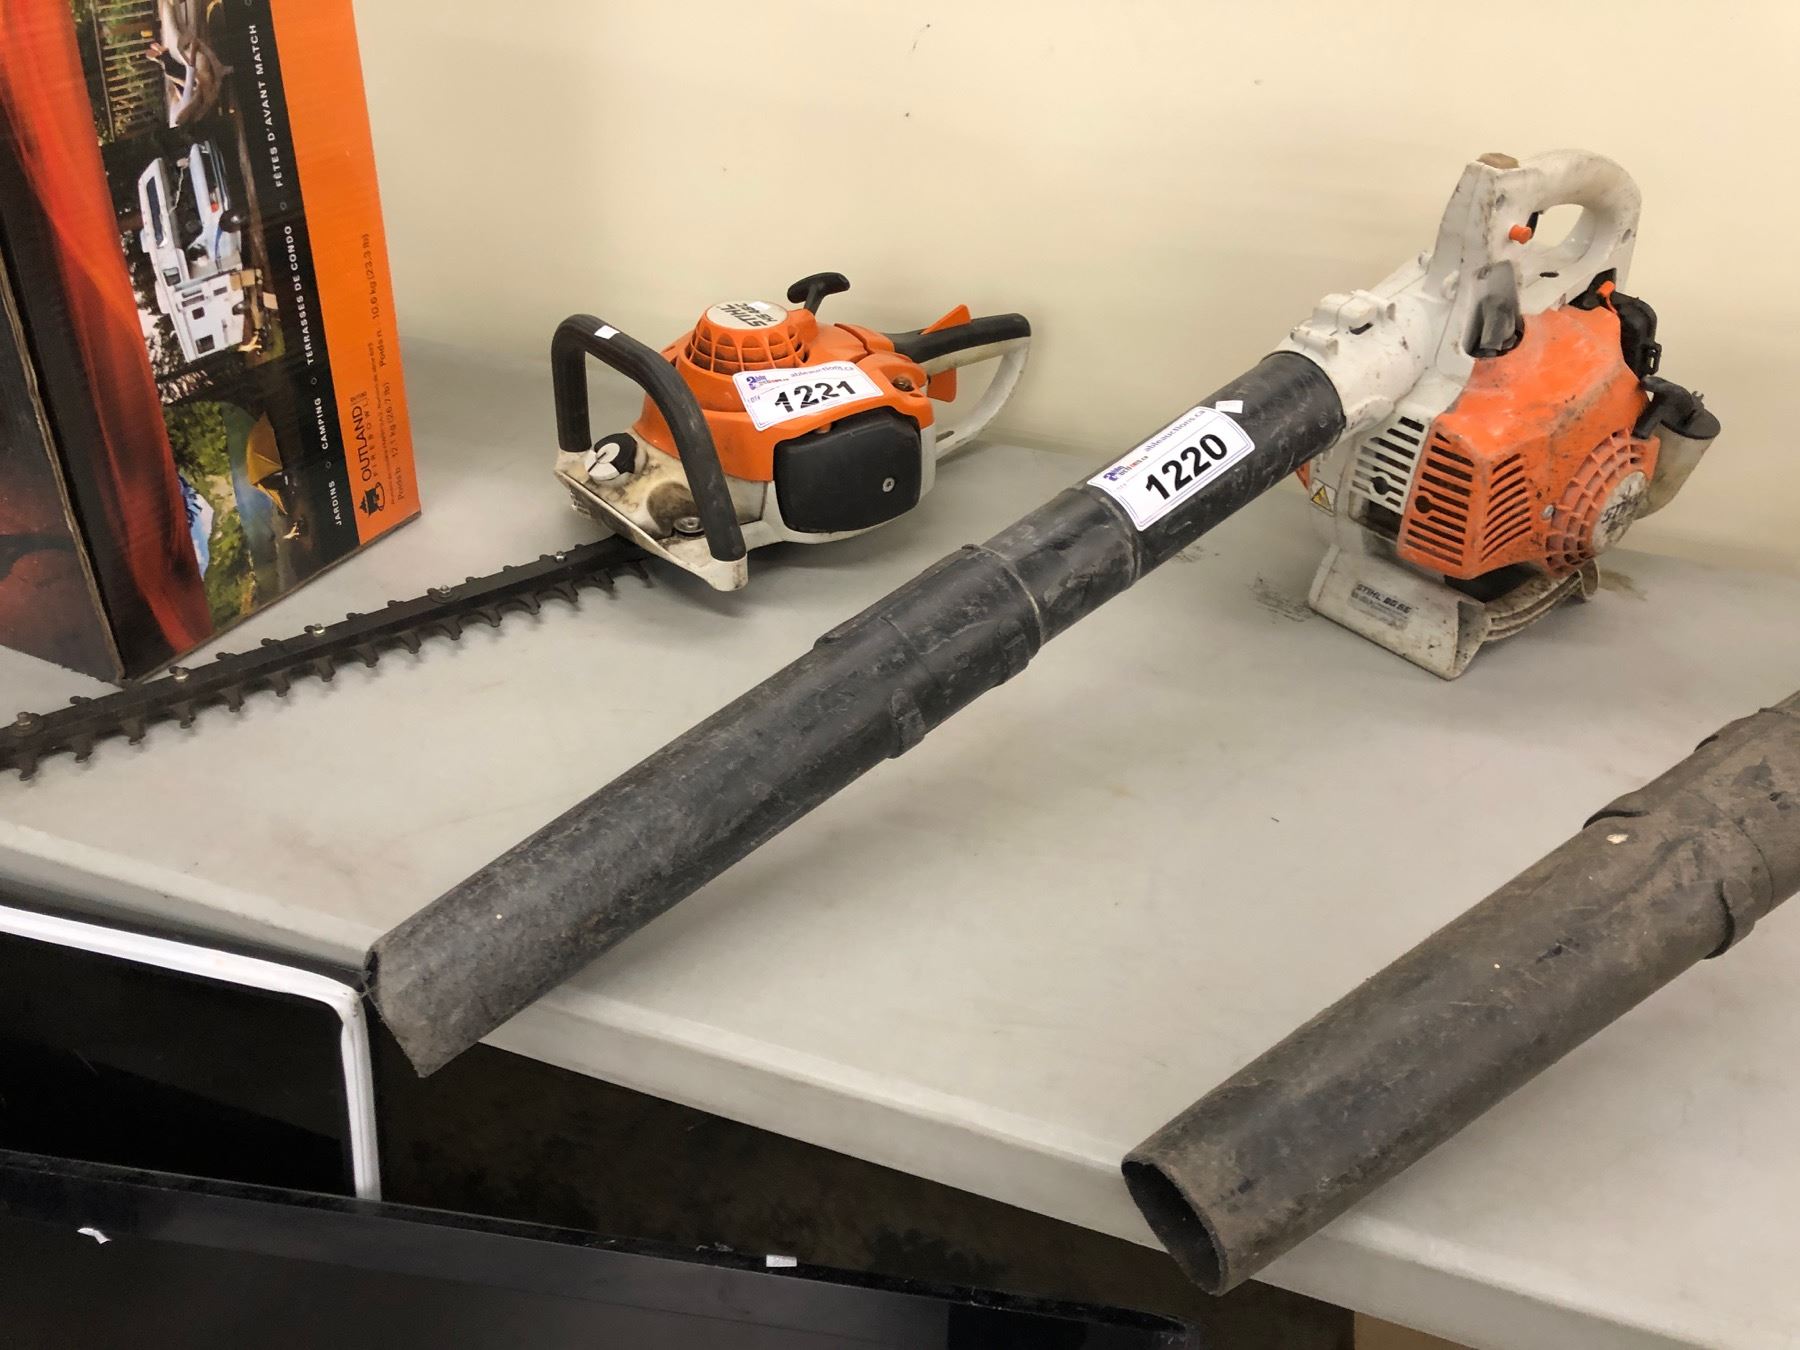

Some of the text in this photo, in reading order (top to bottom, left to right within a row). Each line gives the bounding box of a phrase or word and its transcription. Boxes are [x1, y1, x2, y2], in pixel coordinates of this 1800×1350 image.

[249, 24, 264, 75] MATCH
[258, 81, 276, 141] D'AVANT
[284, 225, 299, 271] CONDO
[292, 274, 302, 292] DE
[369, 280, 377, 295] kg
[296, 294, 314, 366] TERRASSES
[720, 304, 768, 327] STIHL
[377, 338, 386, 368] Poids
[774, 380, 856, 413] 1221
[314, 397, 329, 450] CAMPING
[352, 405, 372, 482] OUTLAND
[364, 401, 377, 477] FIREBOWL
[1144, 410, 1206, 452] ableauctions.ca
[1145, 433, 1228, 500] 1220
[328, 480, 342, 526] JARDINS
